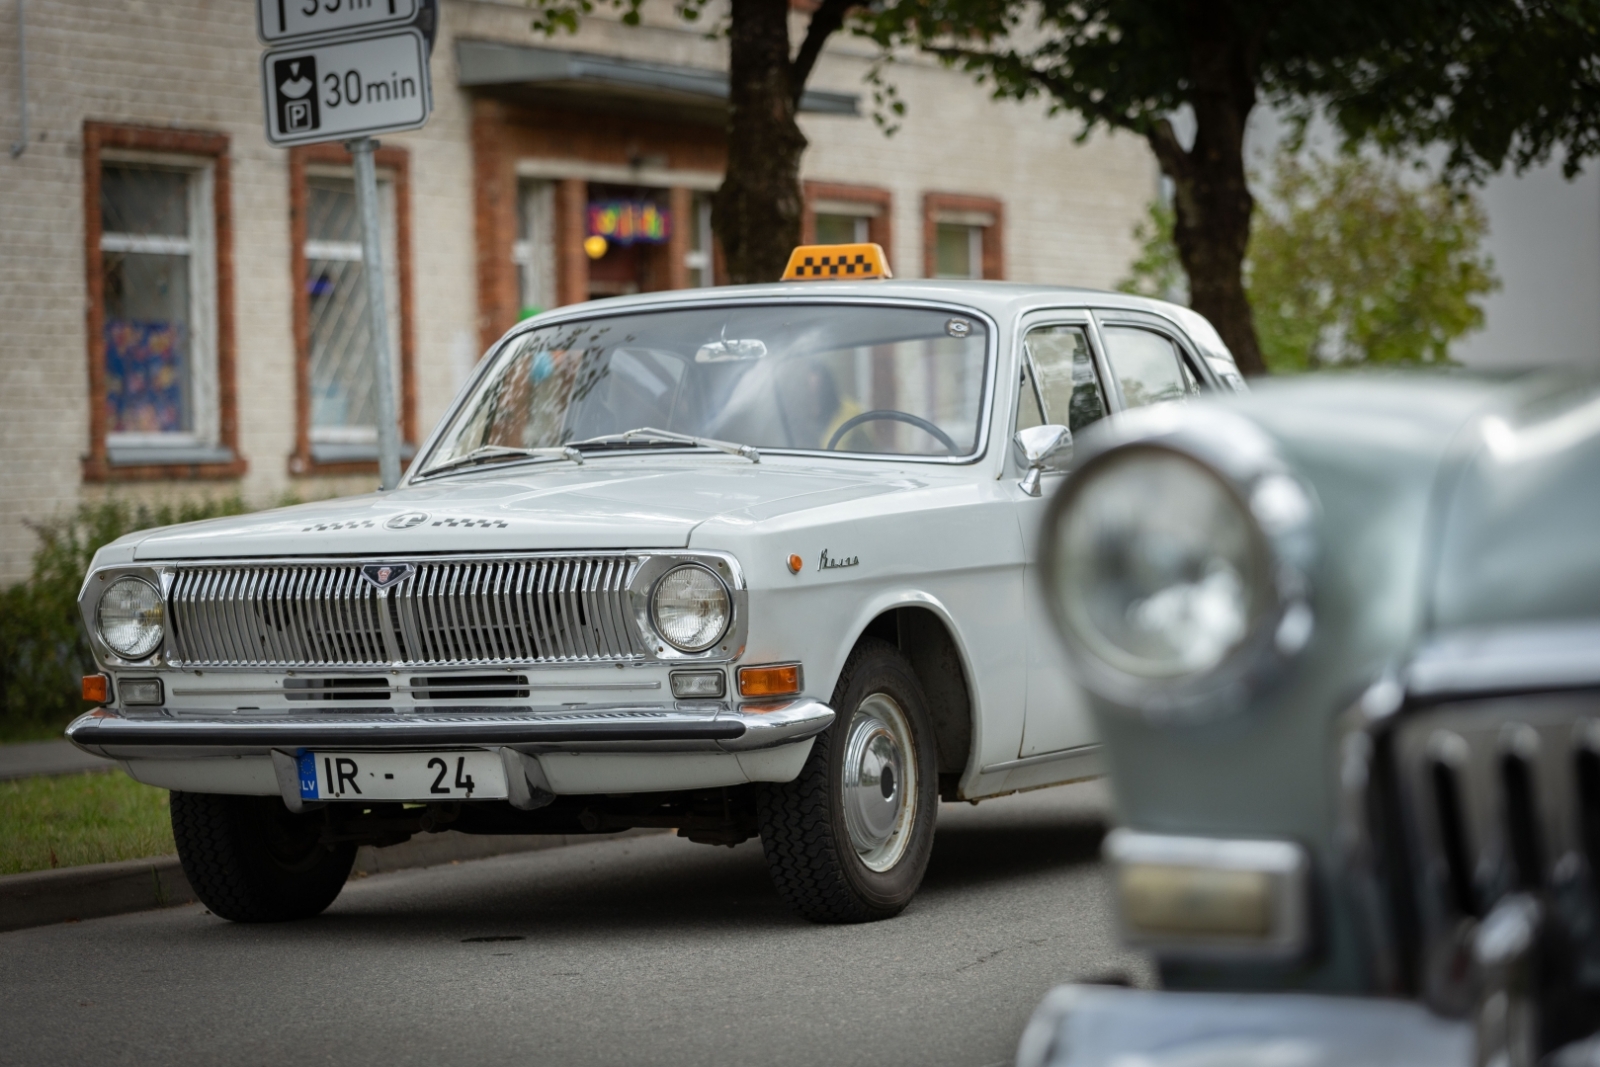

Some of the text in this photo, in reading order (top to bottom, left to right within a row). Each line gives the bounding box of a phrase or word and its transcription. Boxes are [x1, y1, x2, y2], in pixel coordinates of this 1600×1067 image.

[324, 69, 416, 108] 30min
[292, 105, 306, 128] P
[301, 779, 315, 791] LV
